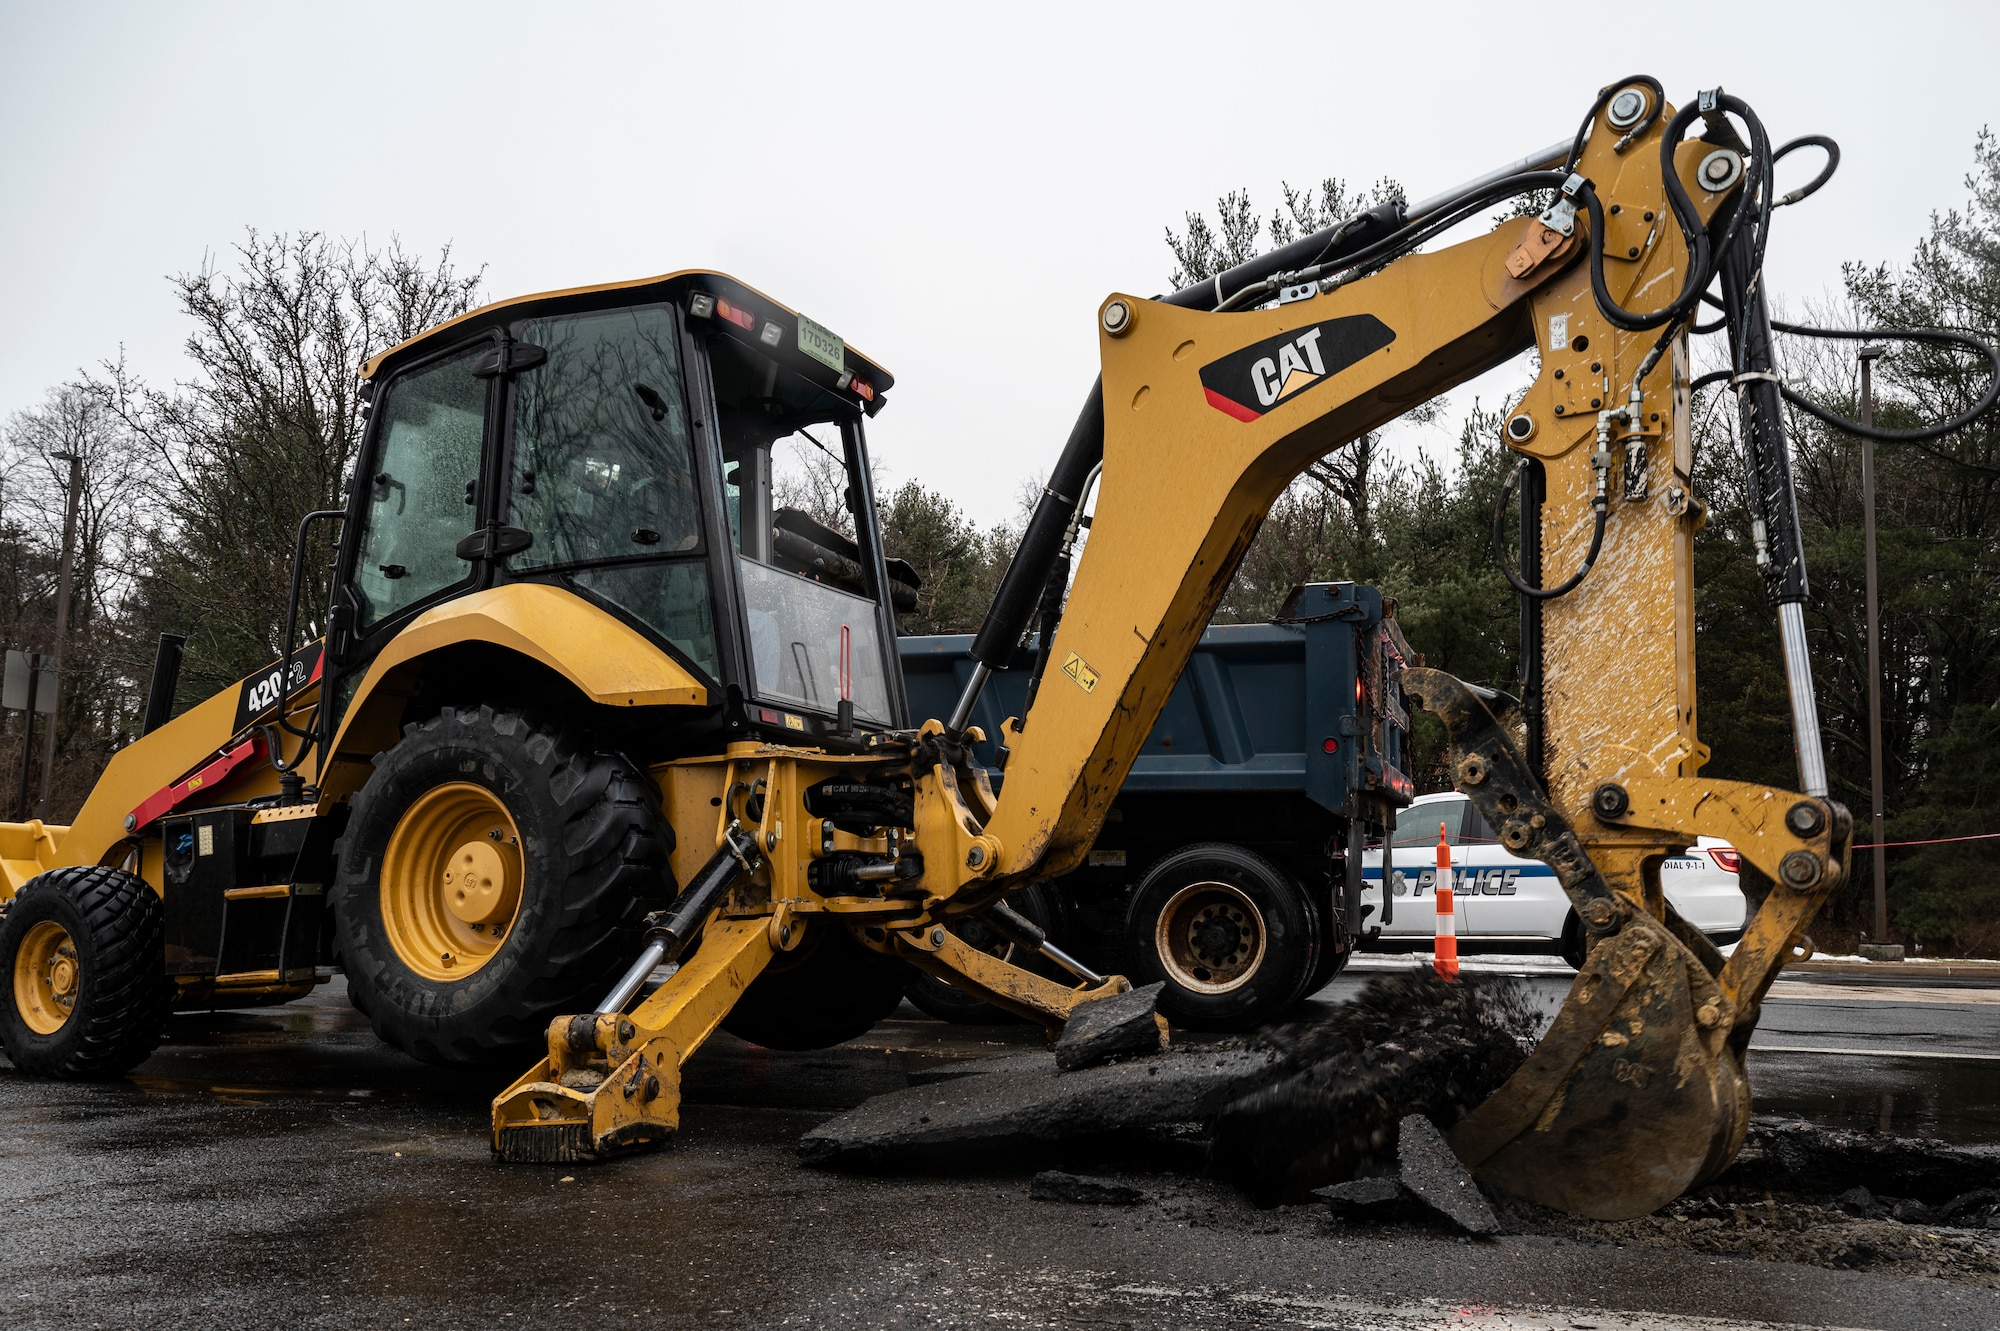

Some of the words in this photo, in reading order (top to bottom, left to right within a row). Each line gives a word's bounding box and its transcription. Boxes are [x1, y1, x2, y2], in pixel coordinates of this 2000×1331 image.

[802, 327, 840, 360] 17D326
[1251, 327, 1326, 406] CAT
[1664, 861, 1683, 869] DIAL
[1685, 861, 1705, 870] 9-1-1
[1413, 869, 1520, 896] PLICE
